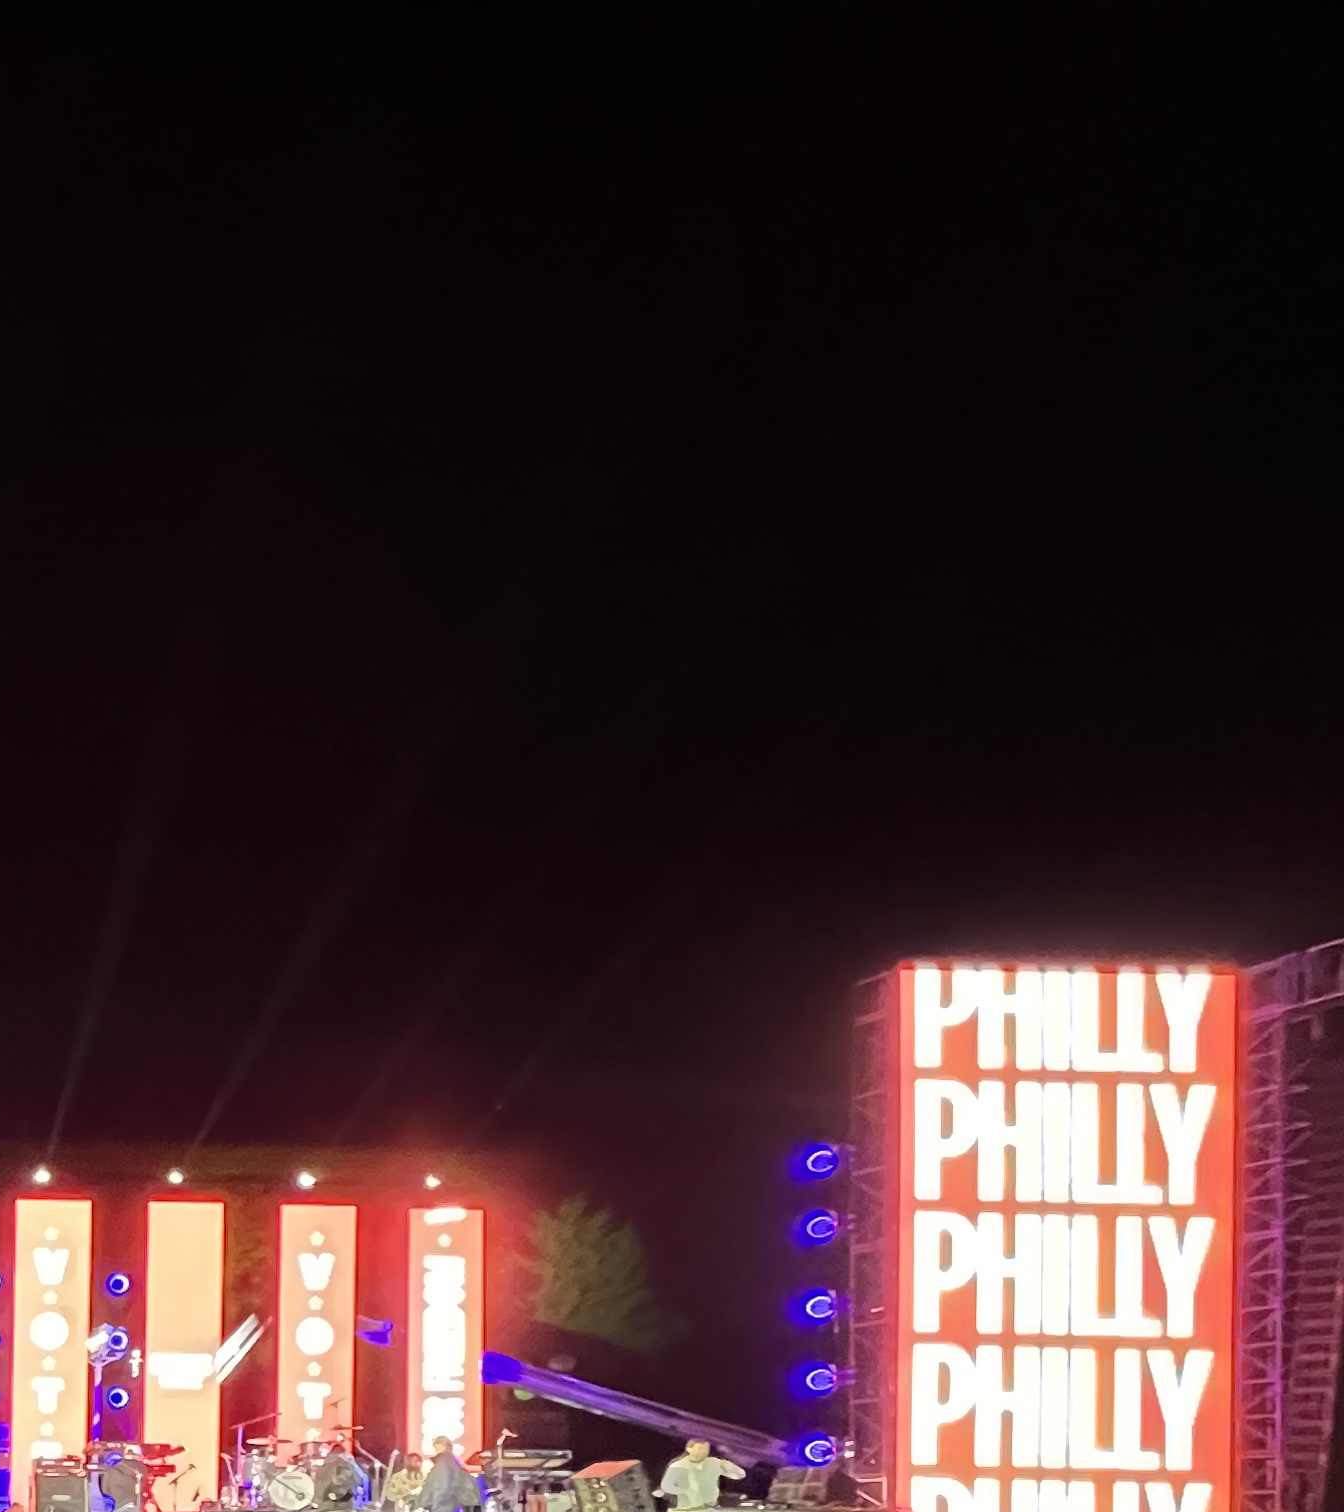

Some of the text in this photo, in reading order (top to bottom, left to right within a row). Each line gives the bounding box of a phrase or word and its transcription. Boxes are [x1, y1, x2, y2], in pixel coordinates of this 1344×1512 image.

[914, 966, 1211, 1073] PHILLY
[914, 1078, 1217, 1205] PHILLY
[913, 1210, 1215, 1338] PHILLY
[910, 1343, 1214, 1471] PHILLY
